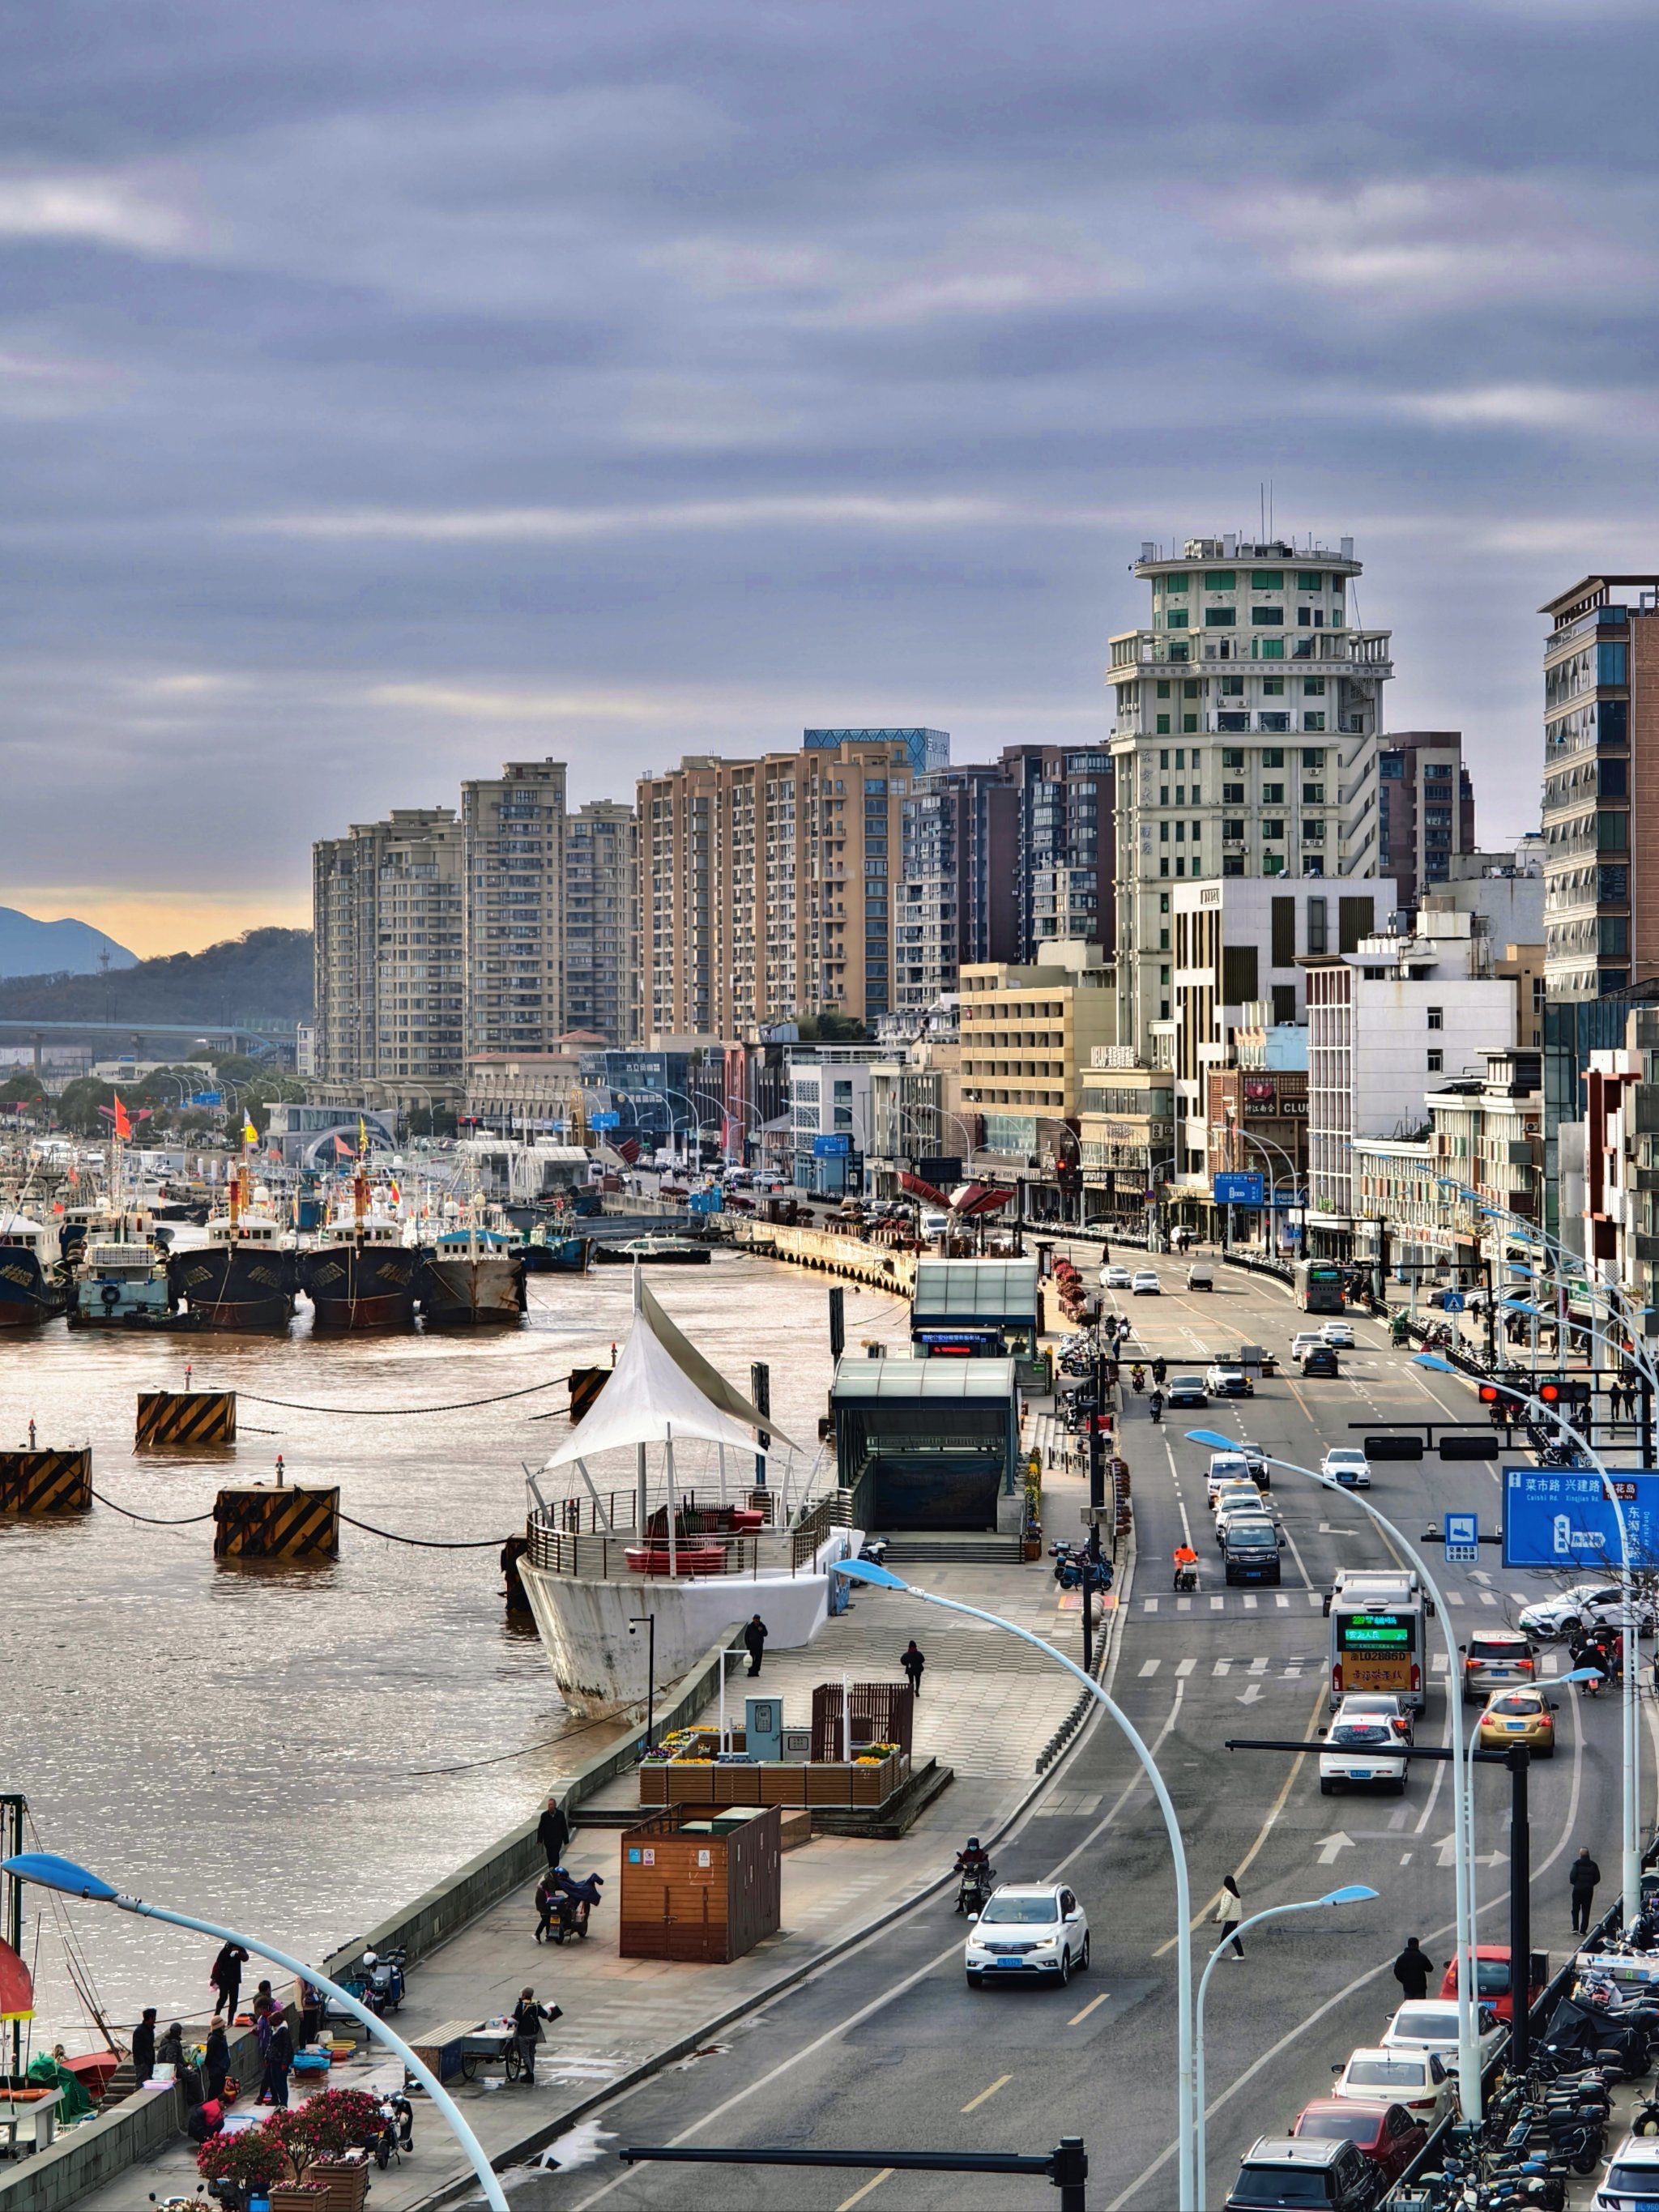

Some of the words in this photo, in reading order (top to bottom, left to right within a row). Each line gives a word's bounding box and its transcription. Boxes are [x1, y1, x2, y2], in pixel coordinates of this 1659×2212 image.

[1525, 1479, 1560, 1492] 菜市路
[1565, 1480, 1600, 1493] 兴建路
